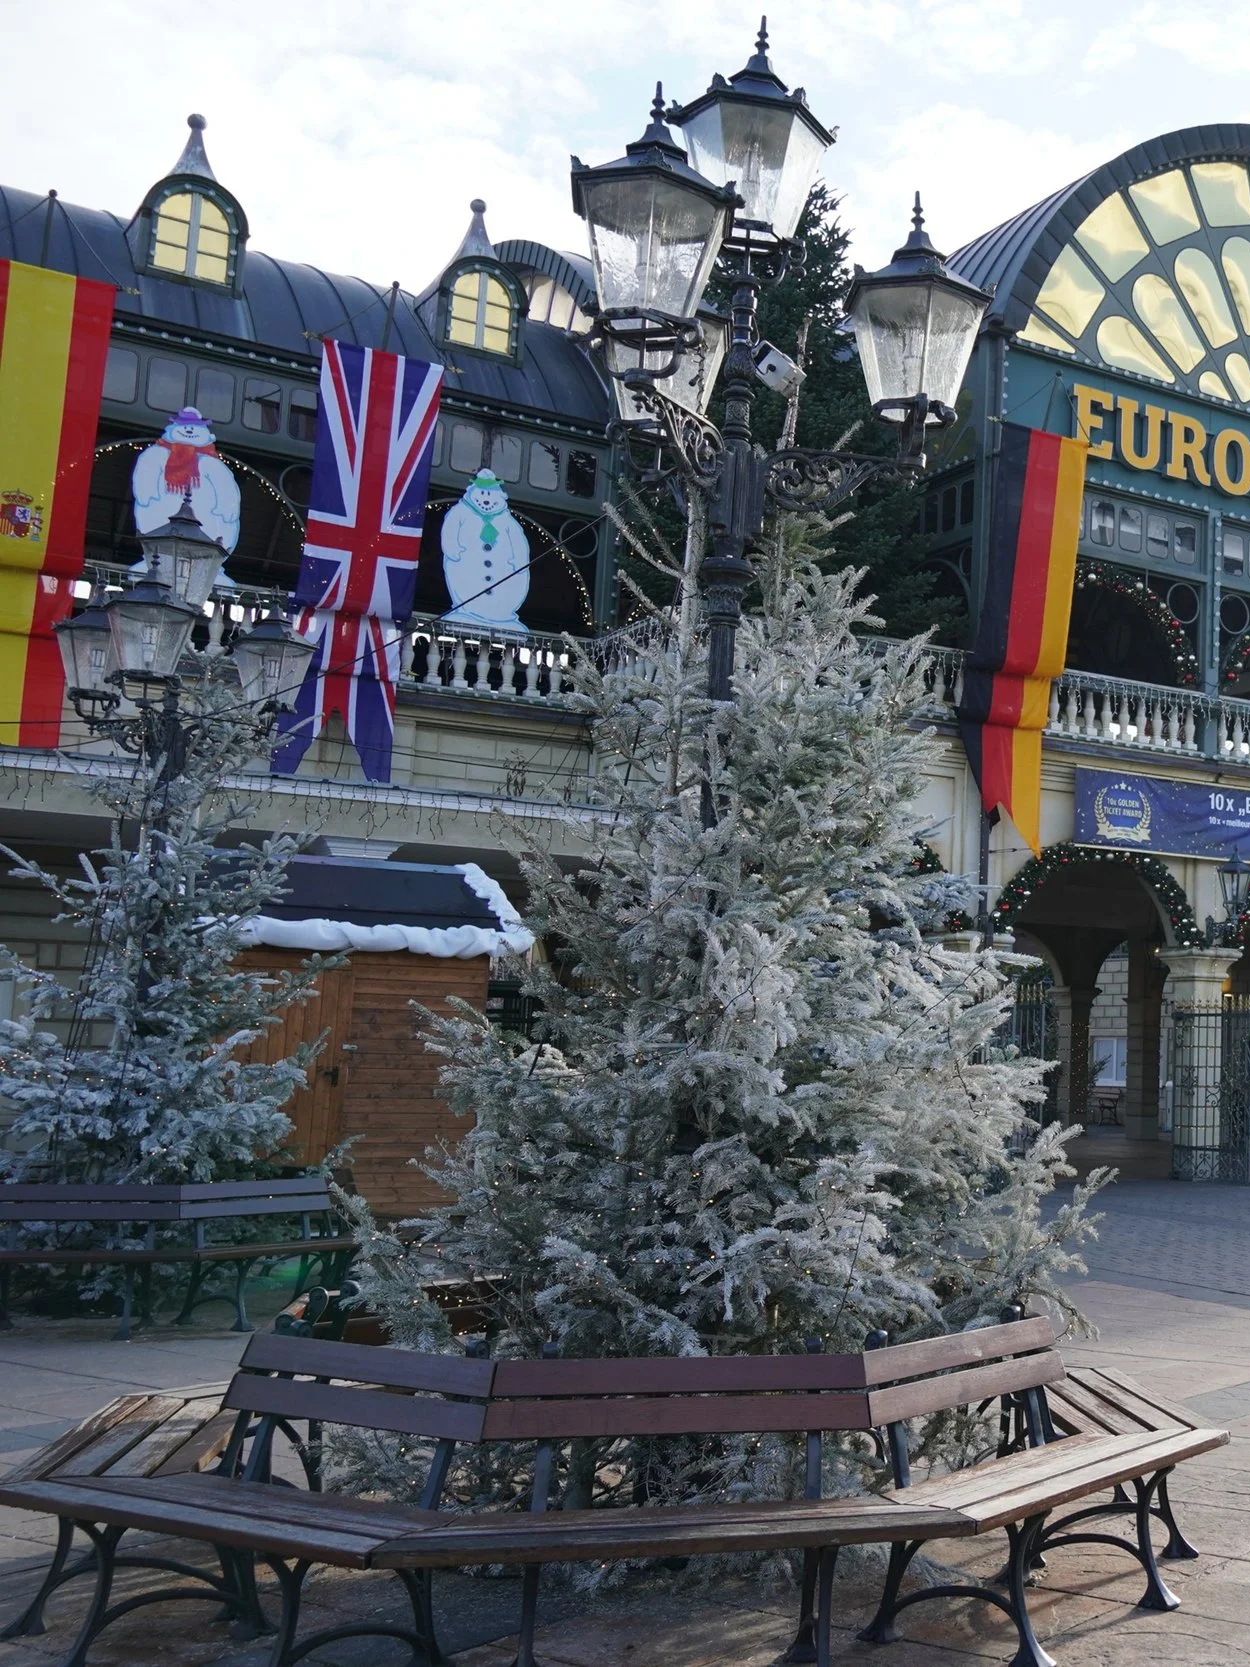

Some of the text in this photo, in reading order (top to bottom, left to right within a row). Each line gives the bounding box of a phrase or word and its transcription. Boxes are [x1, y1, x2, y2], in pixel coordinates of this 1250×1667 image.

[1118, 798, 1140, 808] GOLDEN
[1209, 793, 1224, 810] 10
[1226, 798, 1234, 812] x
[1104, 807, 1143, 818] TICKET AWARD
